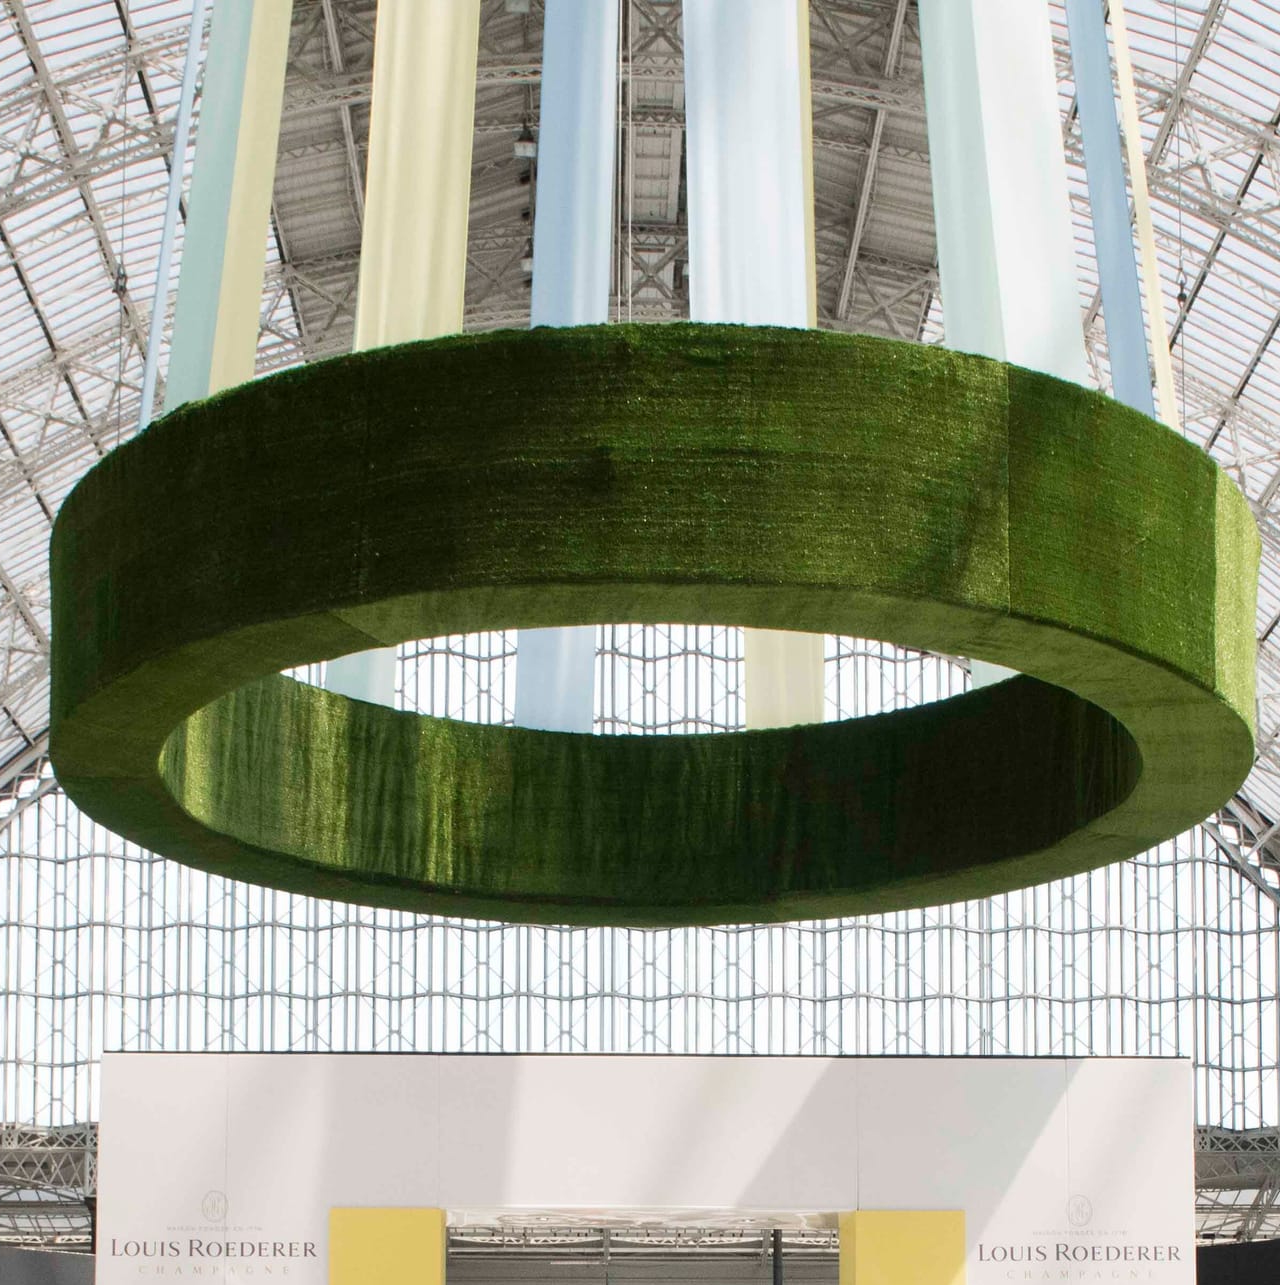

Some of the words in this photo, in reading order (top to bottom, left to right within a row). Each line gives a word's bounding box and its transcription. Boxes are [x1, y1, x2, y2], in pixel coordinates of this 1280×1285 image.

[111, 1238, 181, 1257] LOUIS
[189, 1238, 318, 1258] ROEDERER
[978, 1243, 1047, 1262] LOUIS
[1055, 1243, 1181, 1262] ROEDERER
[138, 1265, 290, 1275] CHAMPAGNE
